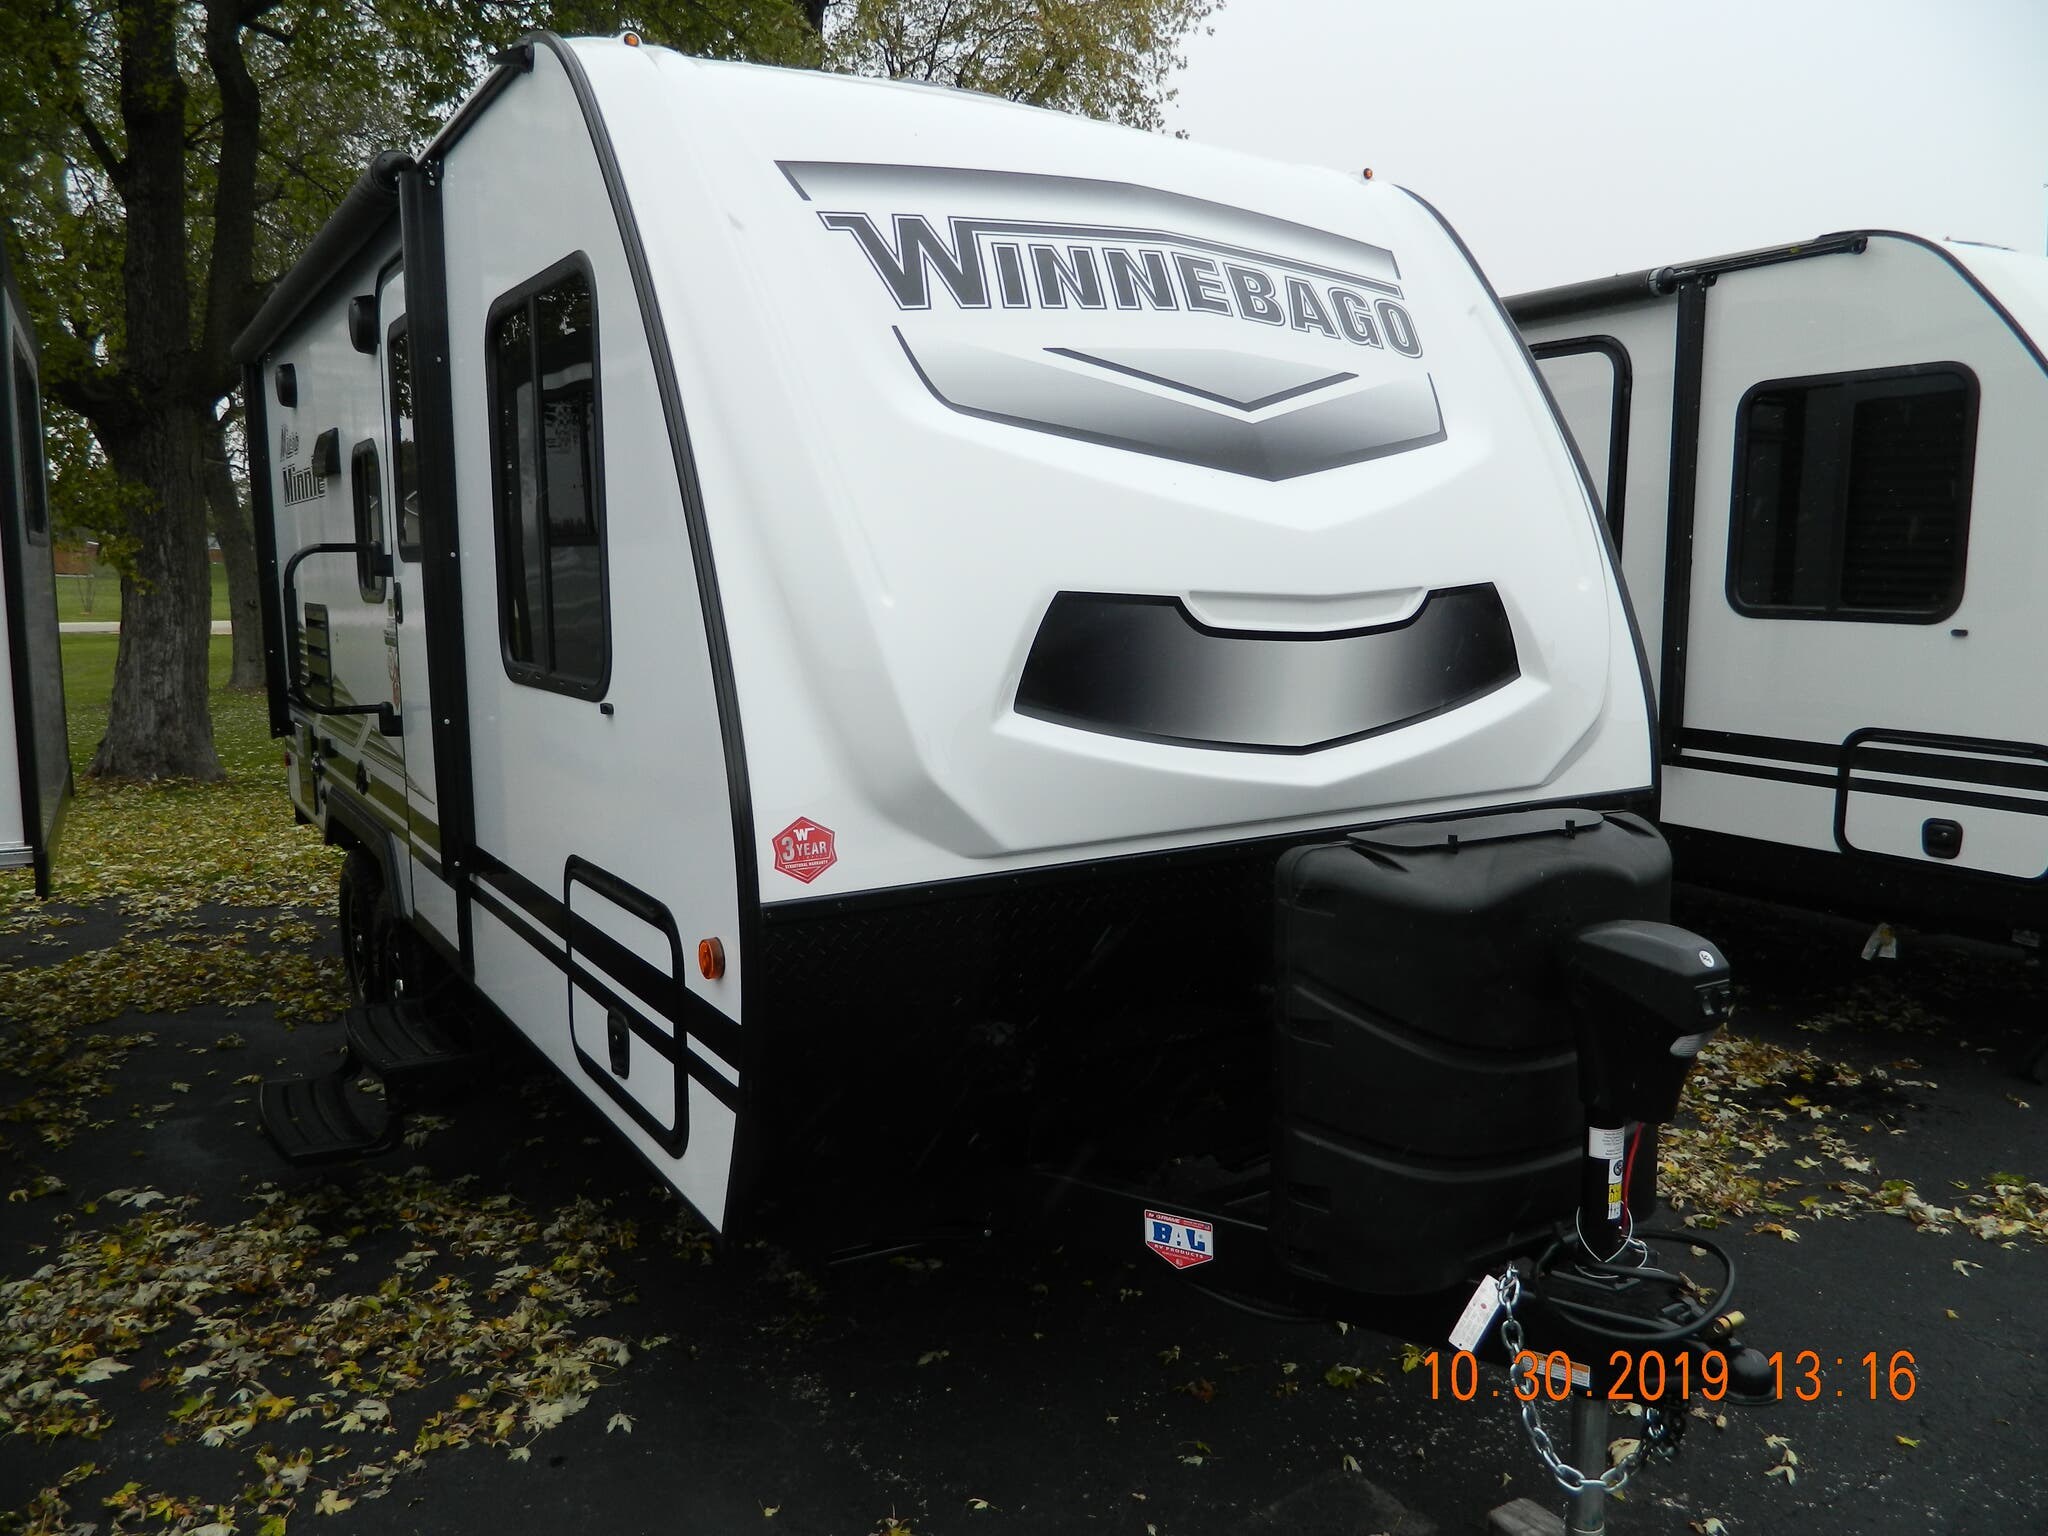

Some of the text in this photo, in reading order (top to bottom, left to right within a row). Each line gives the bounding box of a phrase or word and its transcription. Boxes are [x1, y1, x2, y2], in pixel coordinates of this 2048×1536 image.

[816, 211, 1424, 358] WINNEBAGO
[781, 836, 827, 861] 3 YEAR
[1152, 1221, 1206, 1252] BAL
[1165, 1246, 1204, 1259] PRODUCTS
